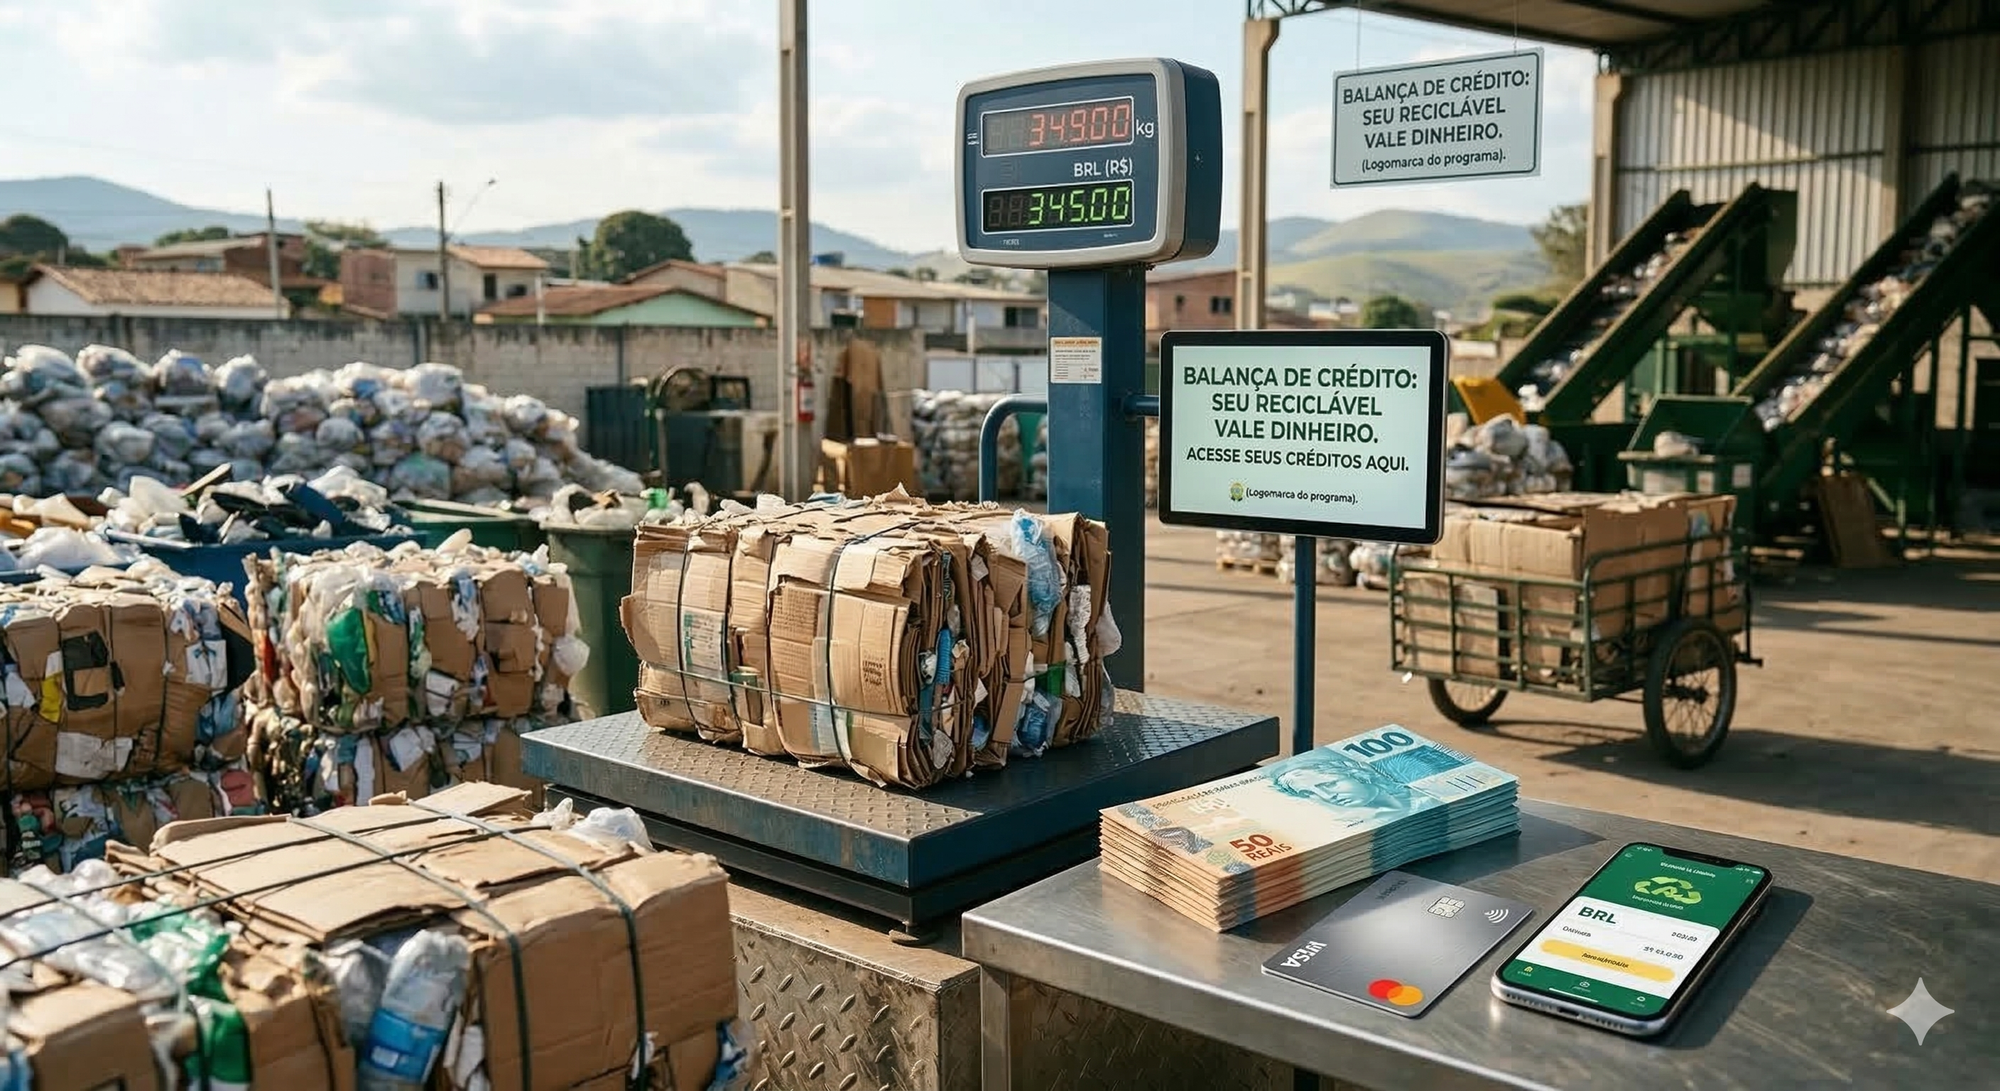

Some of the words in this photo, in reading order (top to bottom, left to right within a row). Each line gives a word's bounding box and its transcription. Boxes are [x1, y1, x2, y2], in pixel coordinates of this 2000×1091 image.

[1343, 82, 1419, 104] BALANÇA
[1423, 79, 1446, 96] DE
[1450, 70, 1529, 93] CRÉDITO:
[1363, 107, 1394, 126] SEU
[1399, 95, 1506, 123] RECICLÁVEL
[1136, 118, 1155, 139] kg
[1364, 130, 1407, 149] VALE
[1411, 123, 1502, 146] DINHEIRO.
[1073, 162, 1101, 177] BRL
[1105, 157, 1133, 178] (R$)
[1362, 154, 1424, 173] (Logomarca
[1427, 154, 1441, 166] do
[1444, 148, 1506, 169] programa).
[1028, 186, 1131, 225] 345.00
[1183, 366, 1278, 391] BALANÇA
[1284, 368, 1311, 387] DE
[1317, 363, 1418, 389] CRÉDITO:
[1212, 393, 1249, 412] SEU
[1256, 391, 1382, 416] RECICLÁVEL
[1215, 419, 1265, 439] VALE
[1271, 420, 1379, 444] DINHEIRO.
[1186, 447, 1241, 463] ACESSE
[1244, 449, 1282, 466] SEUS
[1286, 450, 1362, 470] CRÉDITOS
[1365, 455, 1409, 473] AQUI.
[1297, 486, 1309, 500] do
[1342, 732, 1414, 758] 100
[1229, 834, 1274, 853] 50
[1245, 843, 1293, 861] REAIS
[1578, 905, 1617, 925] BRL
[1280, 940, 1328, 968] VISA
